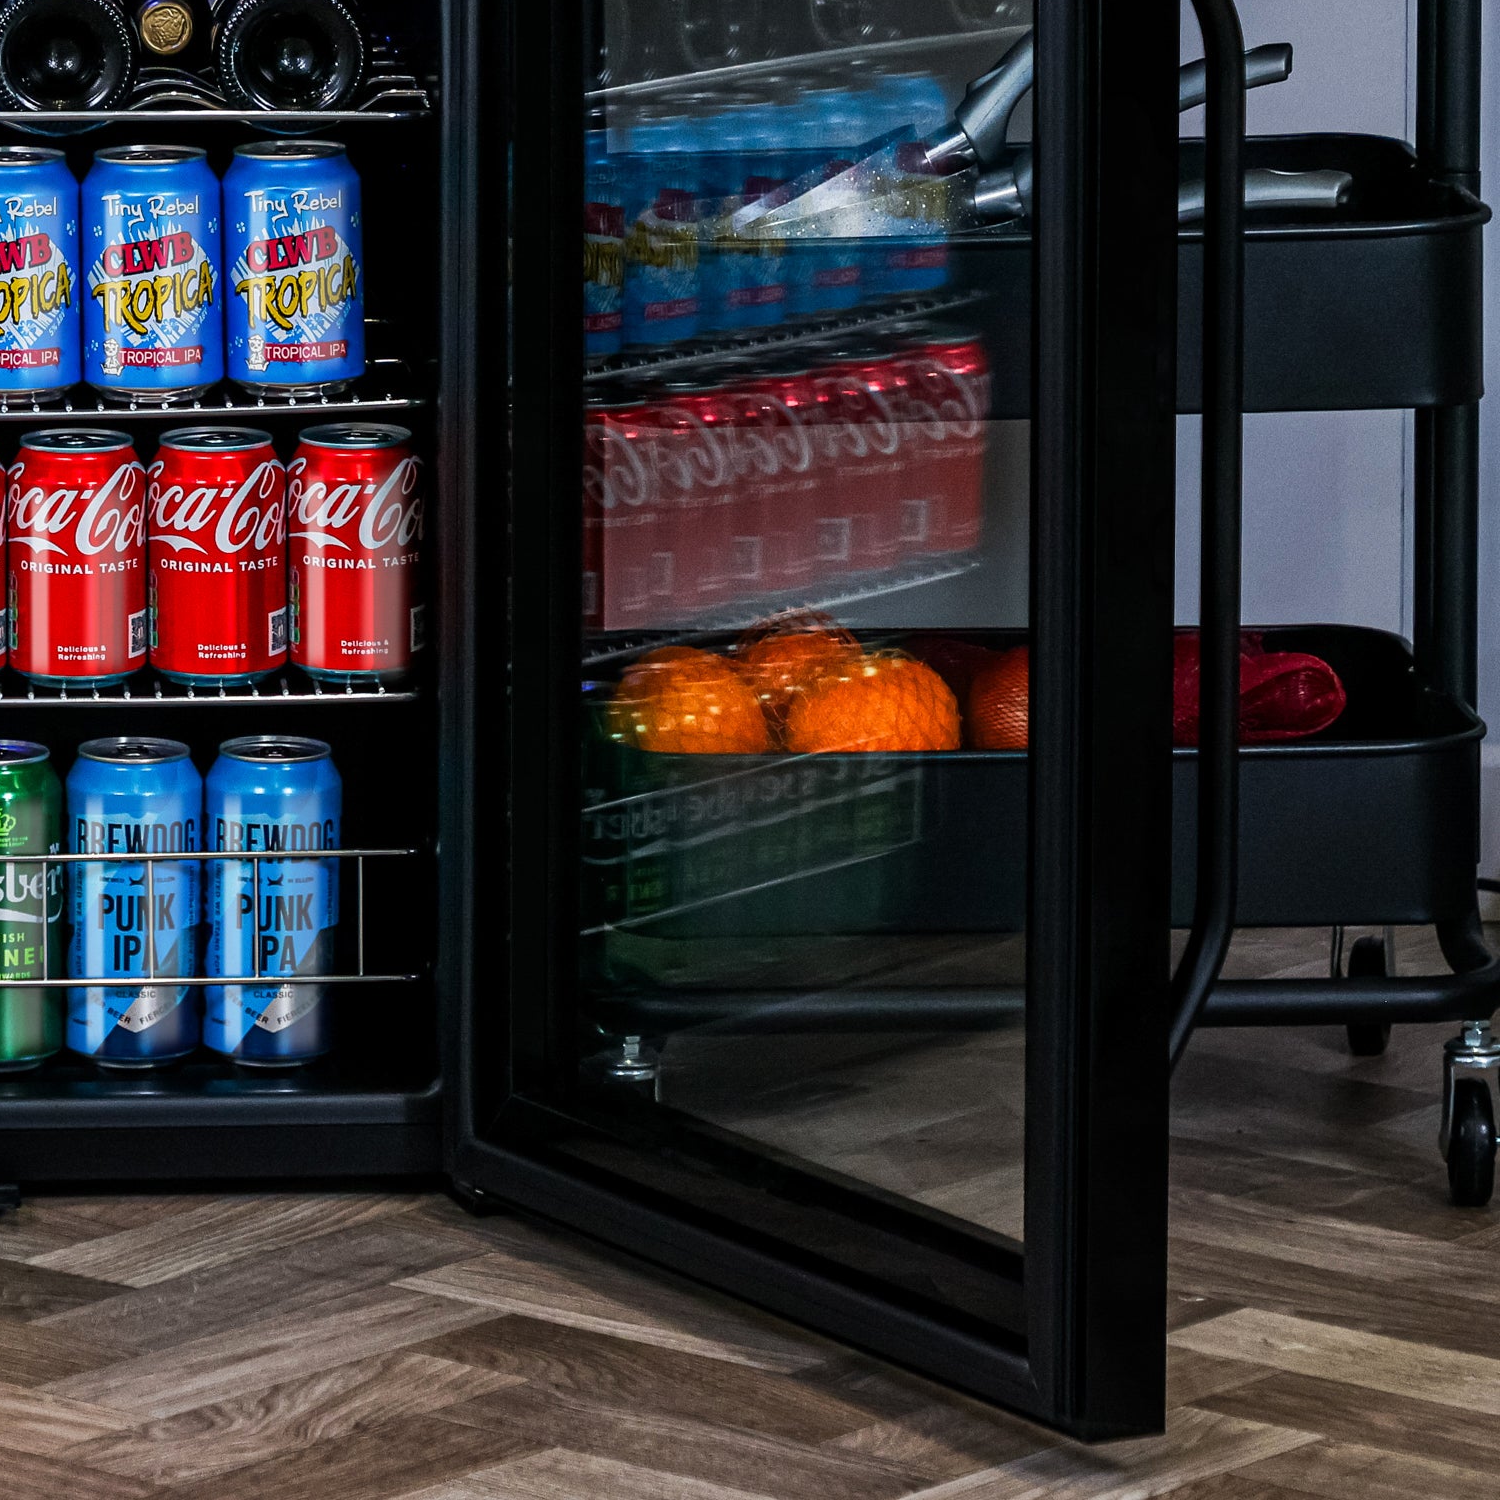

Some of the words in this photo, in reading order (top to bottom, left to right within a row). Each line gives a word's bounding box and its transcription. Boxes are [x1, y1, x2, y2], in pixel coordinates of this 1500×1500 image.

[5, 197, 57, 218] Rebel
[102, 194, 145, 227] Tiny
[147, 196, 199, 217] Rebel
[244, 190, 288, 222] Tiny
[291, 191, 342, 214] Rebel
[102, 231, 195, 277] CLWB
[246, 226, 338, 274] CLWB
[92, 261, 213, 335] TROPICA
[236, 254, 357, 331] TROPICA
[41, 351, 59, 363] IPA
[120, 350, 180, 364] TROPICAL
[184, 350, 201, 362] IPA
[265, 345, 325, 360] TROPICAL
[329, 344, 346, 356] IPA
[21, 560, 93, 574] ORIGINAL
[100, 558, 138, 573] TASTE
[161, 558, 233, 573] ORIGINAL
[239, 556, 278, 572] TASTE
[303, 555, 376, 569] ORIGINAL
[383, 552, 420, 567] TASTE
[198, 651, 246, 659] Refreshing
[97, 893, 175, 932] PUNK
[236, 893, 314, 932] PUNK
[114, 935, 159, 971] IPA
[116, 990, 156, 999] CLASSIC
[254, 990, 294, 999] CLASSIC
[107, 1007, 131, 1025] BEER
